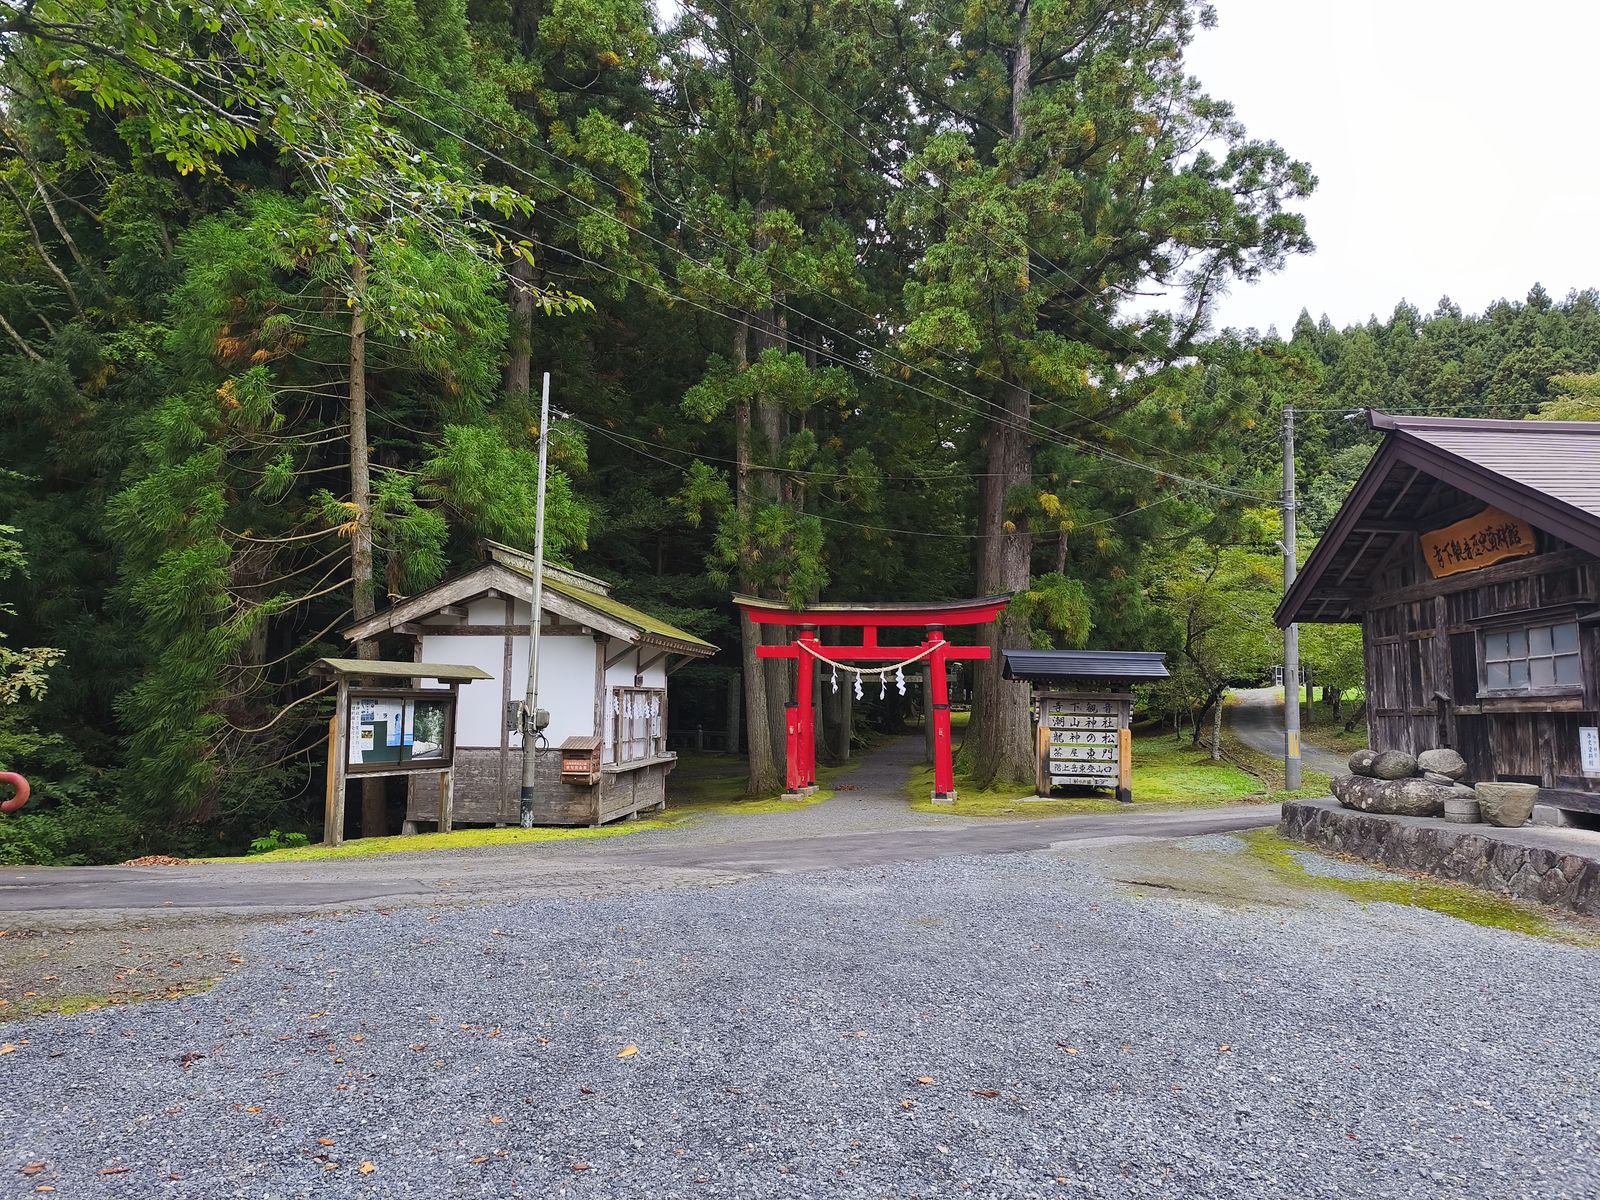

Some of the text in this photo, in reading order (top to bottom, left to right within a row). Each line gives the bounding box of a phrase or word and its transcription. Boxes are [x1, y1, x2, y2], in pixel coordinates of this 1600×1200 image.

[1052, 701, 1113, 713] 寺下観音
[1052, 716, 1114, 728] 潮山神社
[1053, 731, 1115, 744] 龍神の松
[1053, 747, 1113, 760] 茶屋東門
[1054, 763, 1112, 774] 階上岳東登山口
